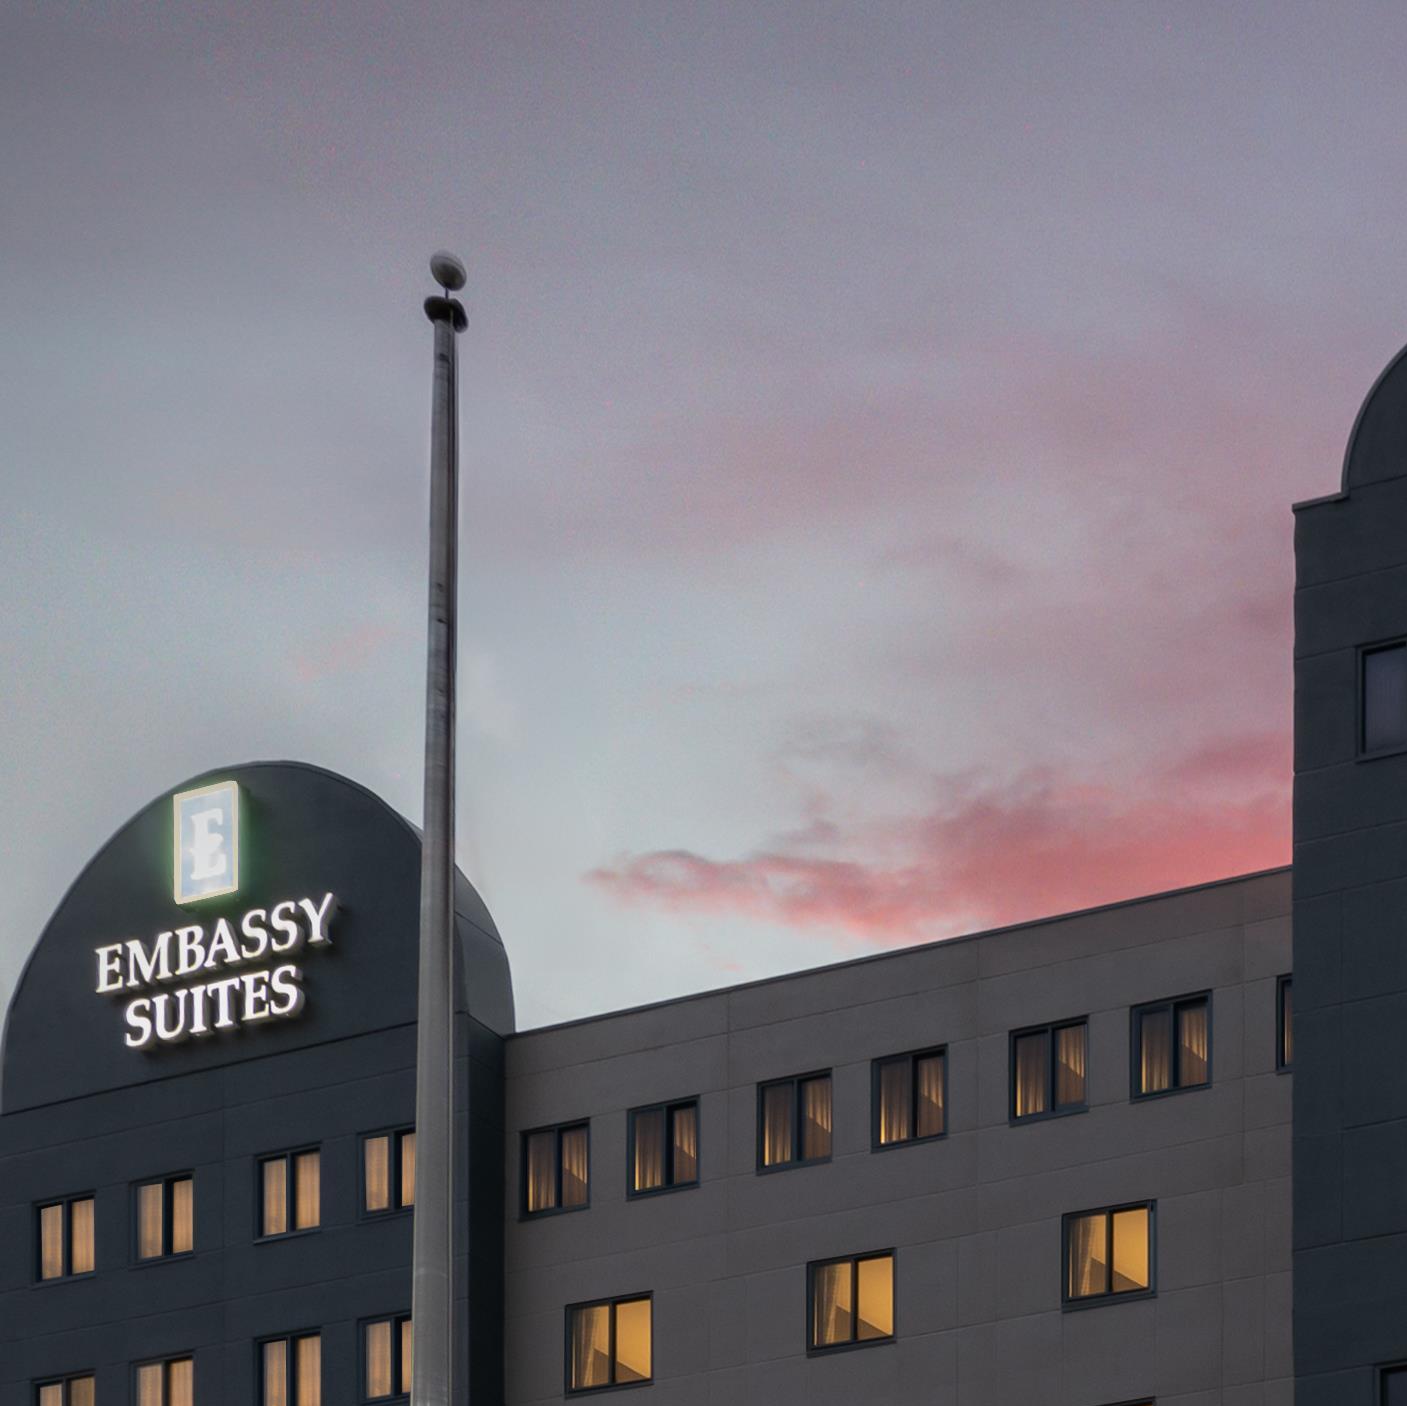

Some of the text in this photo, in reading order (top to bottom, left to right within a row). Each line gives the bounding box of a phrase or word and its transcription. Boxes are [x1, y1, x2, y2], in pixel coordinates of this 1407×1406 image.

[189, 808, 228, 881] E
[95, 892, 334, 994] EMBASSY
[125, 965, 301, 1048] SUITES
